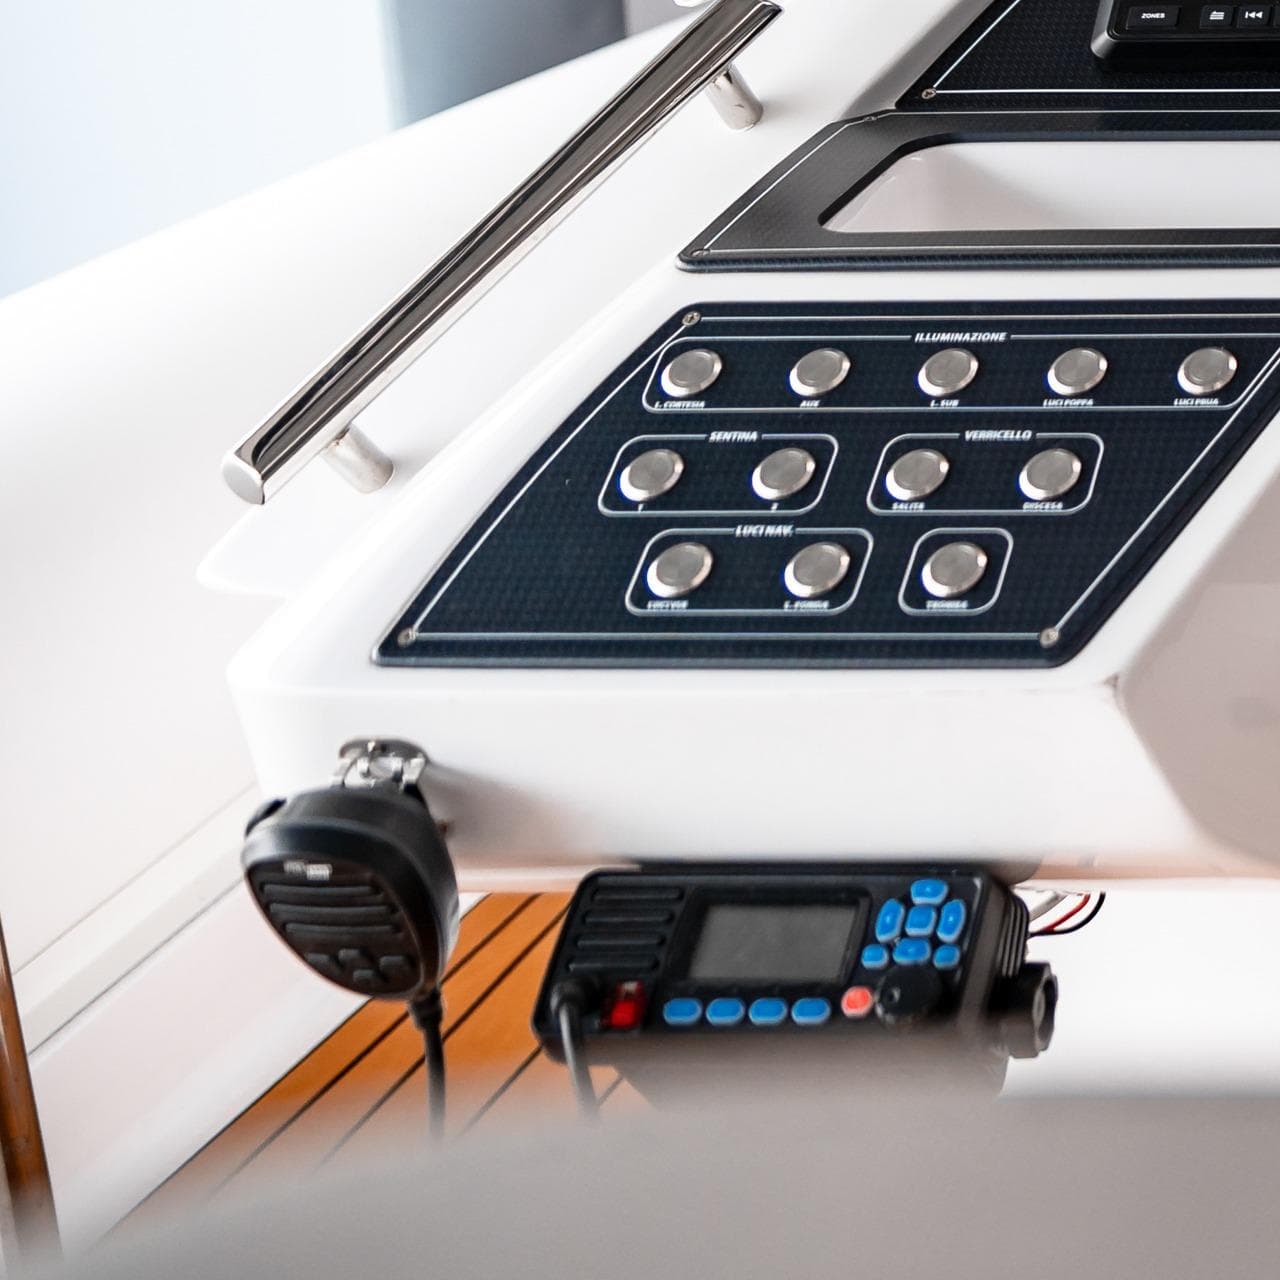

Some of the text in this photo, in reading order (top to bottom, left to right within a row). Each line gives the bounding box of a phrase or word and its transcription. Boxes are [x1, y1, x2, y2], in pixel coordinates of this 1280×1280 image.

[914, 332, 1009, 343] ILLUMINAZIONE
[1043, 399, 1063, 407] LUCI
[1174, 398, 1194, 406] LUCI
[709, 431, 760, 443] SENTINA
[964, 429, 1033, 441] VERRICELLO
